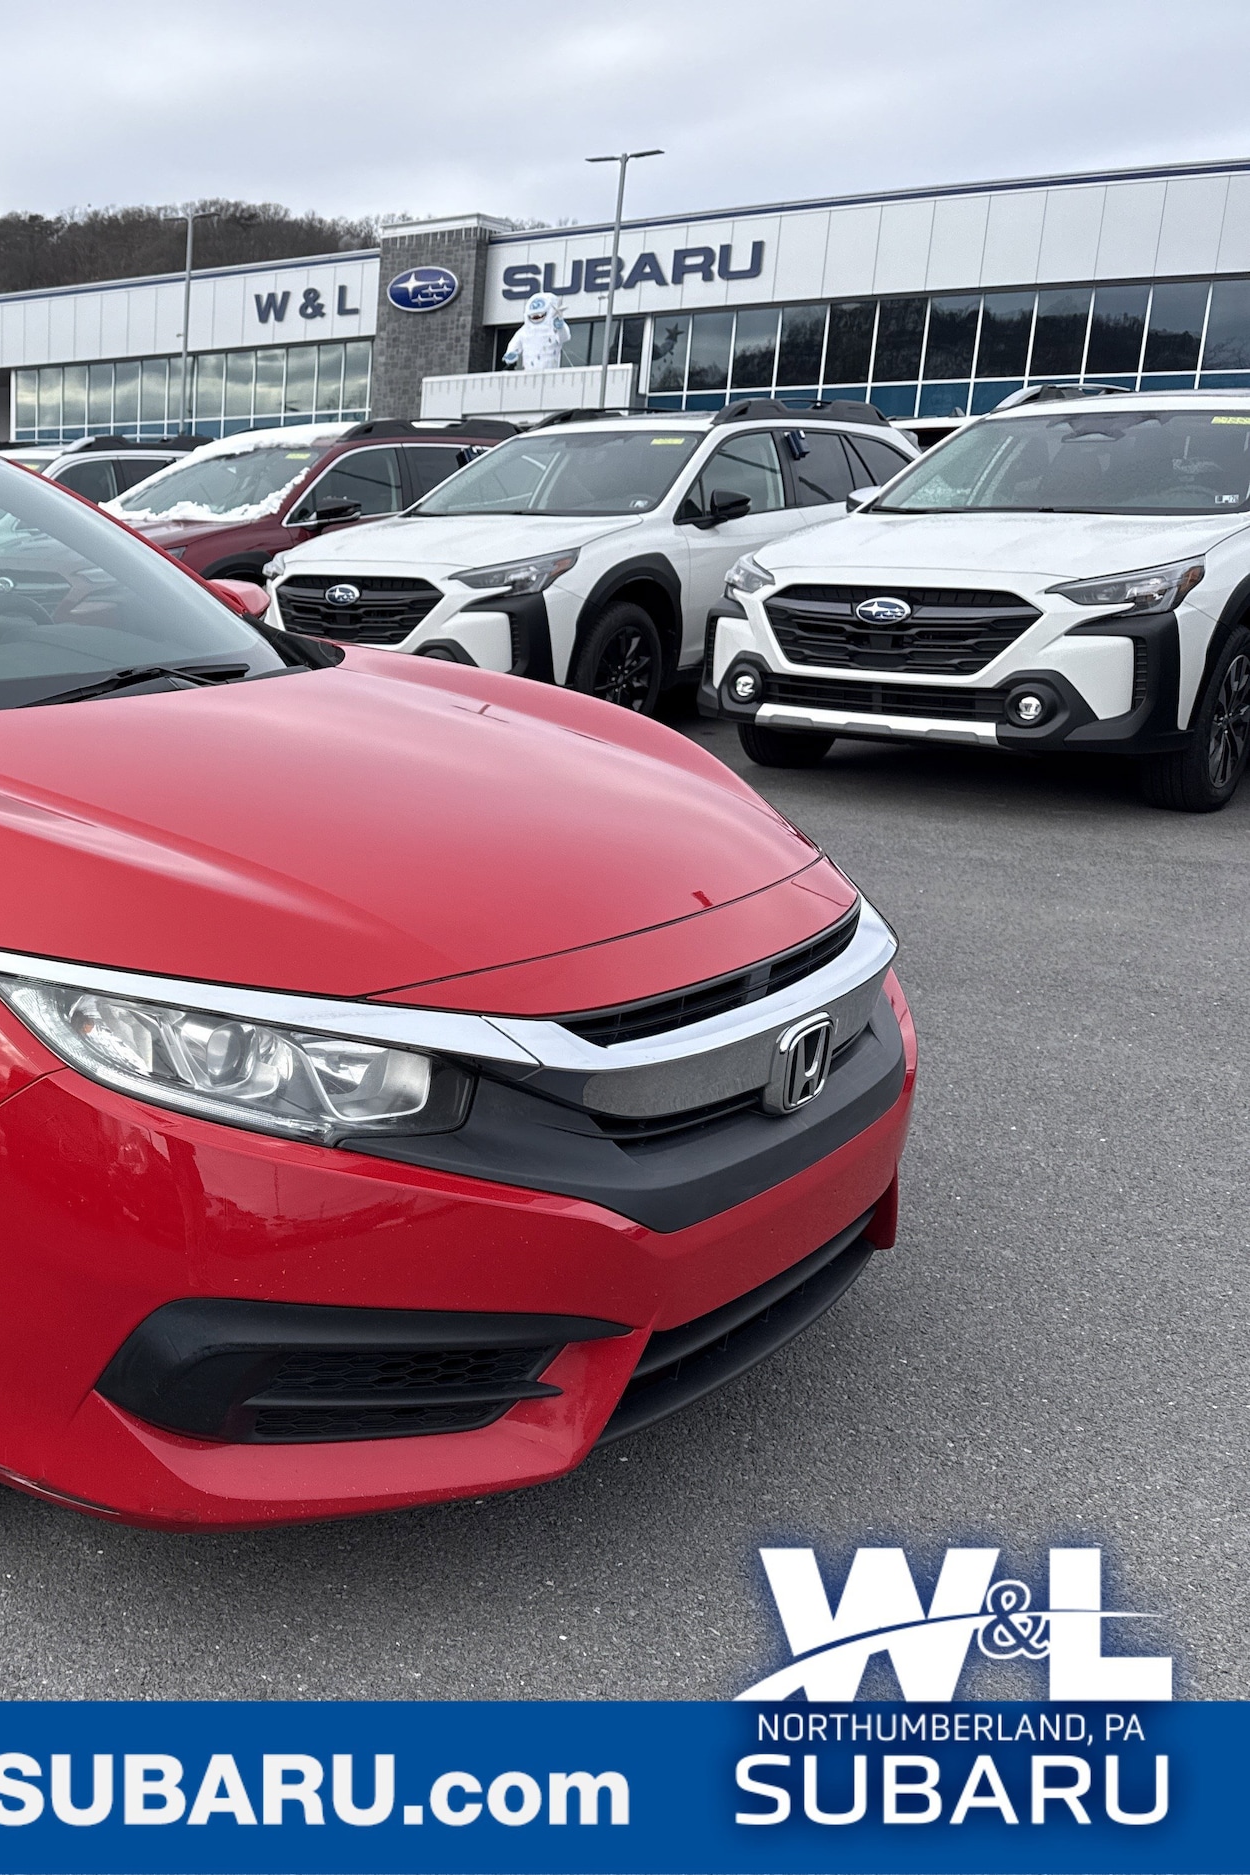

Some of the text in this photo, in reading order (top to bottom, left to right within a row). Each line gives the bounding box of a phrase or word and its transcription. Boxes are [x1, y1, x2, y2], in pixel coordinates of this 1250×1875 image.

[502, 240, 765, 300] SUBARU
[254, 285, 360, 324] W & L
